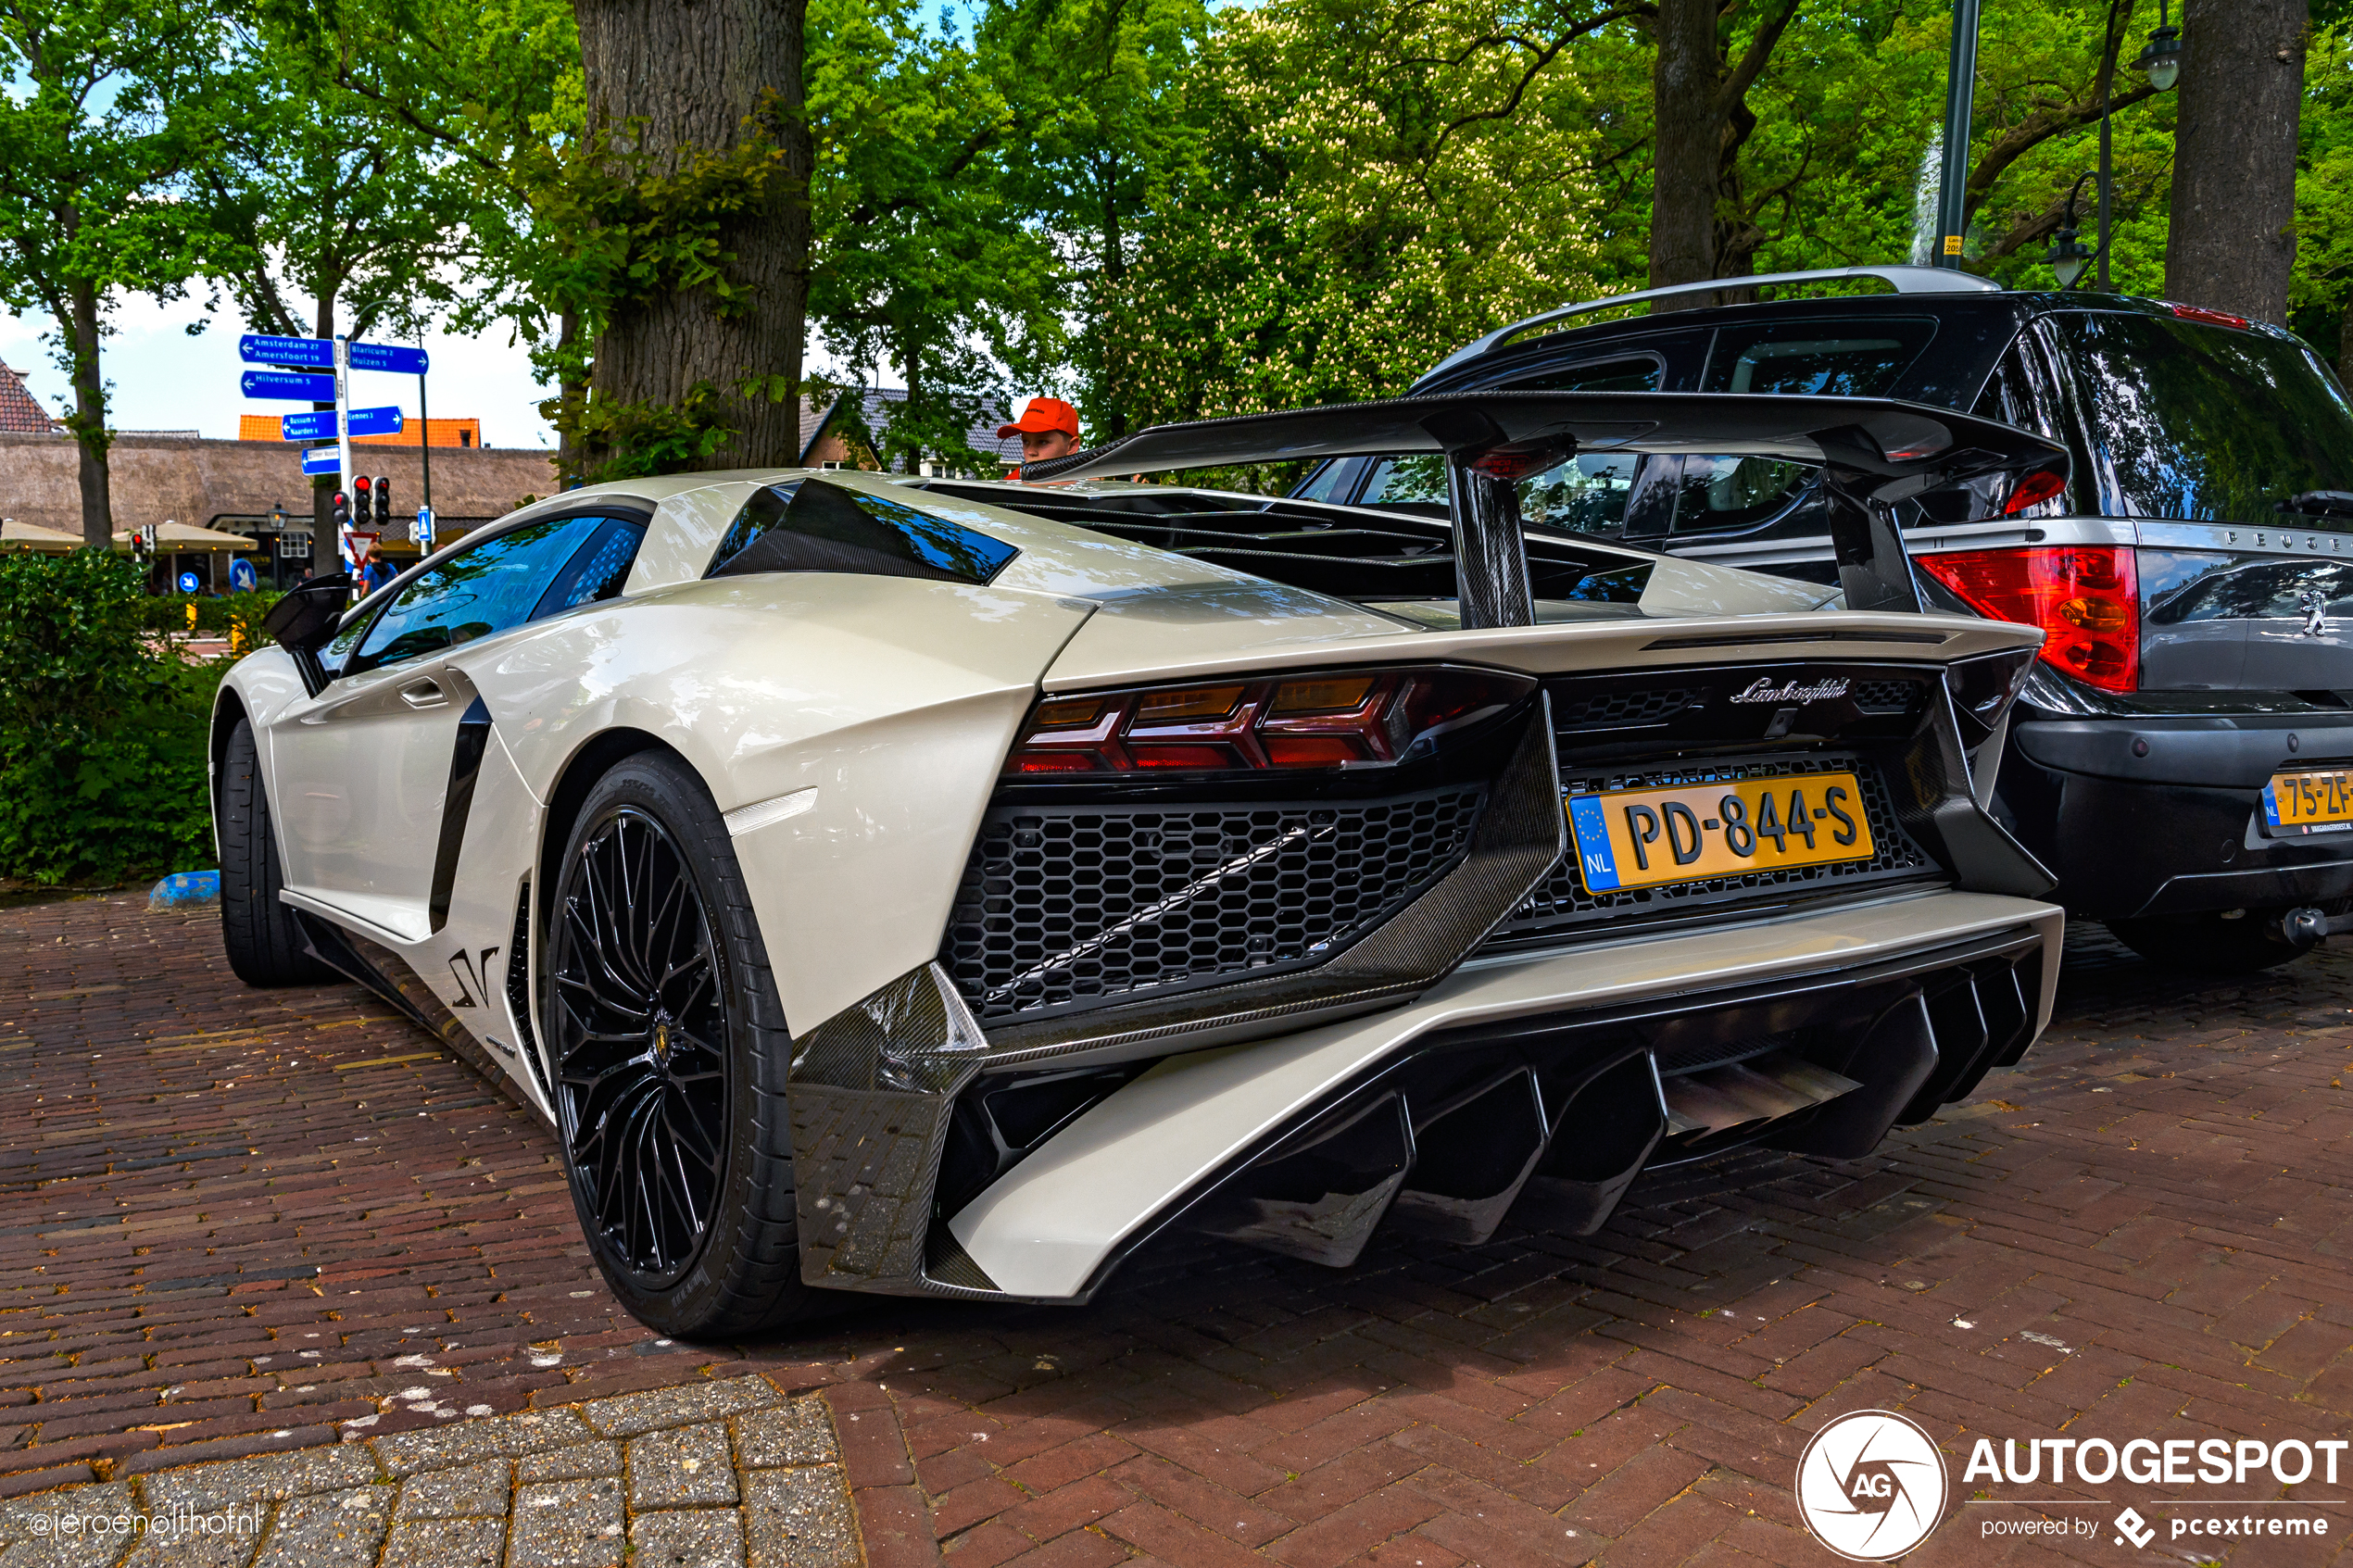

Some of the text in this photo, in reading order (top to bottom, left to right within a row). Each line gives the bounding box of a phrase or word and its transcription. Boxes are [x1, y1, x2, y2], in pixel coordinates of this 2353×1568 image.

[254, 338, 319, 351] Amsterdam 27
[351, 345, 387, 357] Blaricum
[254, 350, 308, 361] Amersfoort
[352, 358, 381, 367] Huizen
[255, 374, 303, 385] Hilversum
[2224, 531, 2353, 553] PEUGE
[1730, 676, 1851, 706] Lamborghini
[2265, 805, 2278, 818] NL
[1623, 785, 1857, 871] PD-844-S
[1586, 853, 1612, 874] NL
